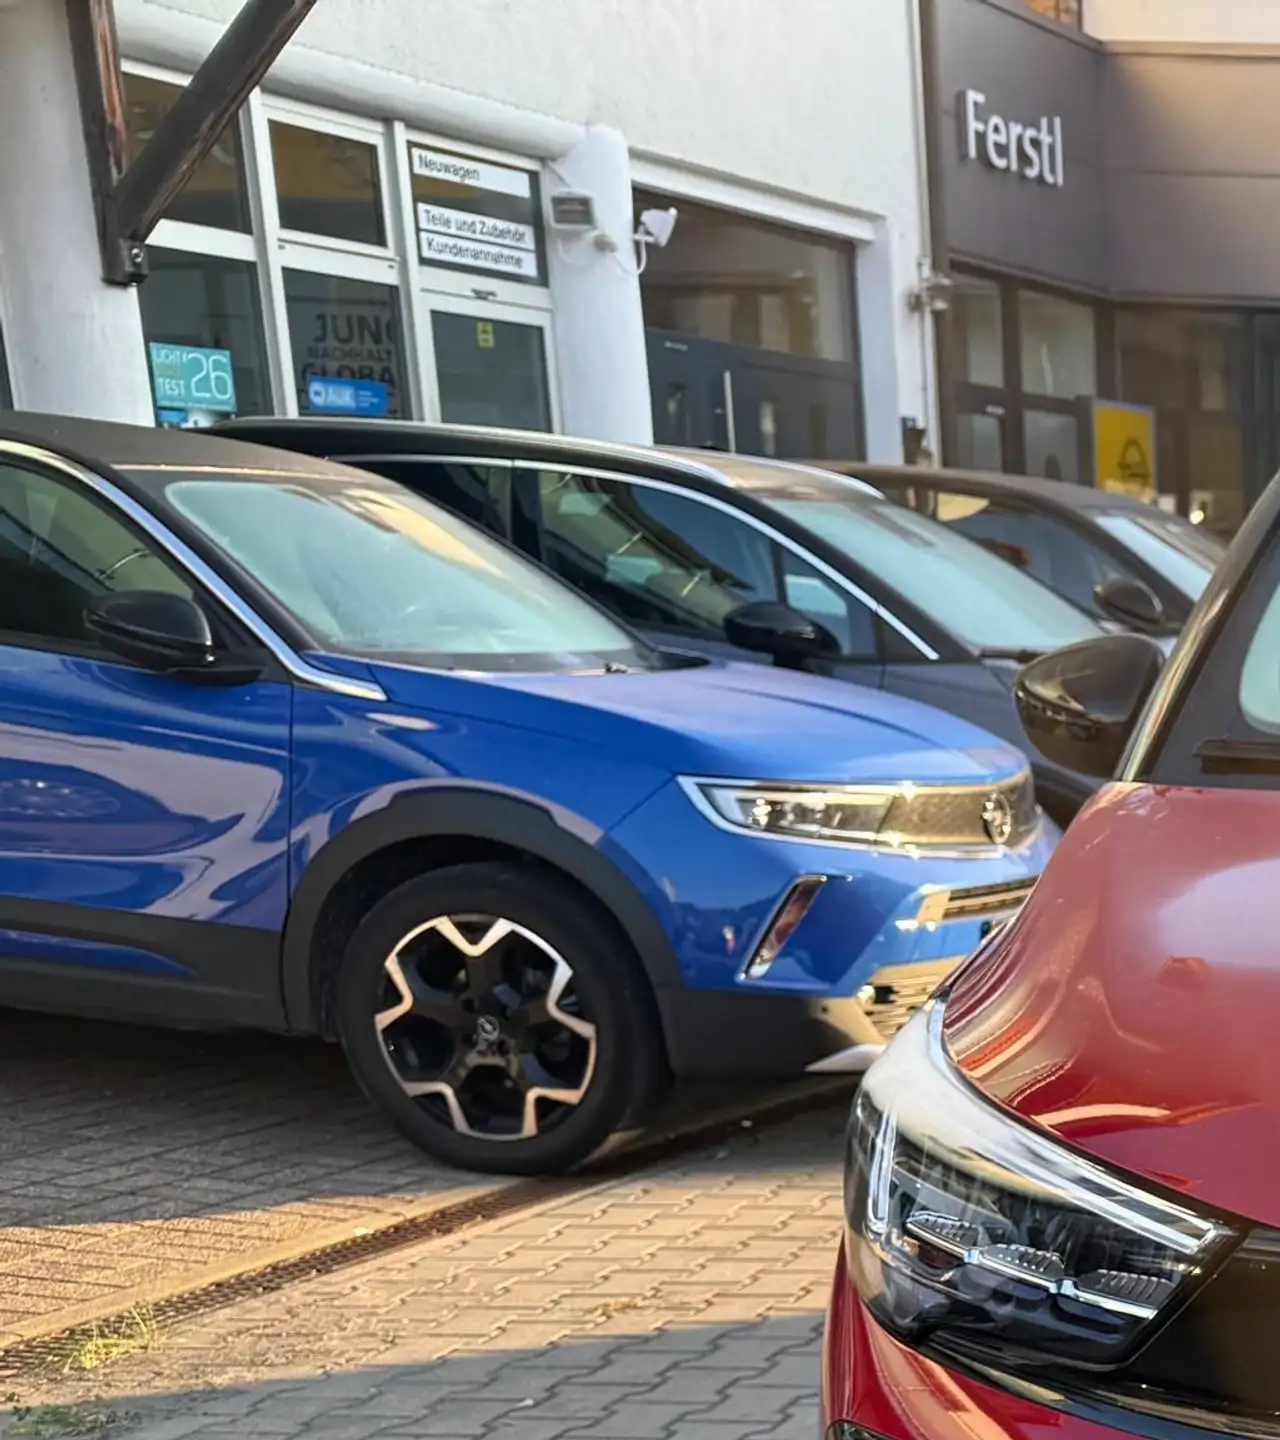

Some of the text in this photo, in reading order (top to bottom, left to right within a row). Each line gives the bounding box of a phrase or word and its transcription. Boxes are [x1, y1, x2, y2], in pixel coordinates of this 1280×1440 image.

[966, 87, 1064, 187] Ferstl
[418, 152, 480, 182] Neuwagen
[423, 208, 452, 230] Teile
[454, 217, 477, 235] und
[158, 377, 185, 396] TEST
